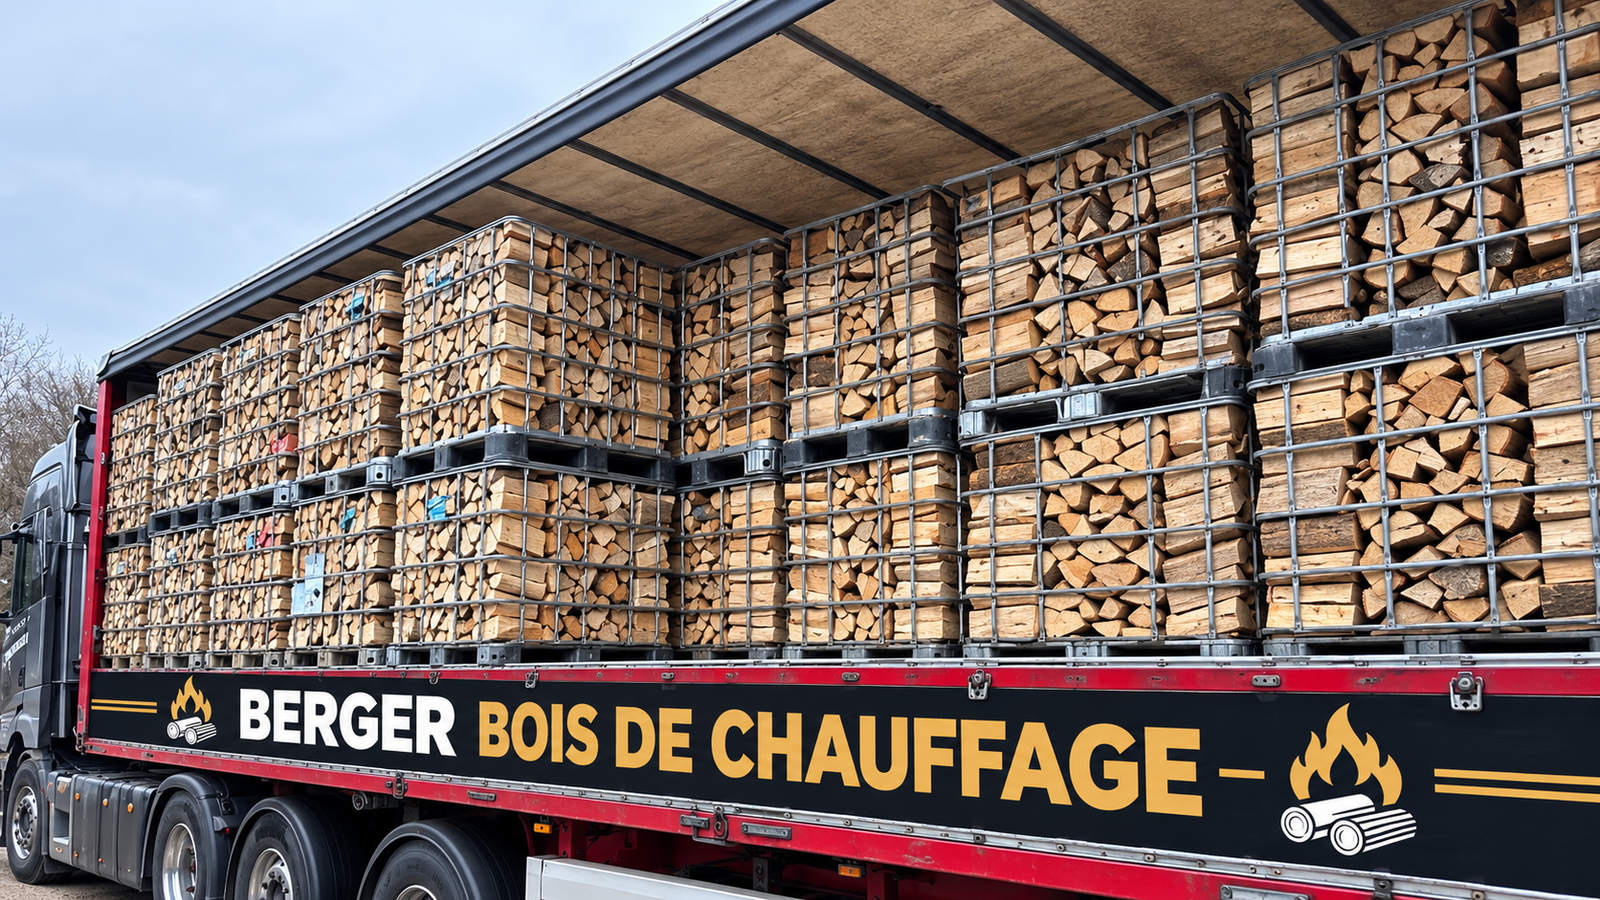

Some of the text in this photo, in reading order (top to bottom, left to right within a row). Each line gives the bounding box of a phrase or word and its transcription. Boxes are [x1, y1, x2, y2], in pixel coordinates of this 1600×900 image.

[239, 689, 1203, 818] BERGER BOIS DE CHAUFFAGE
